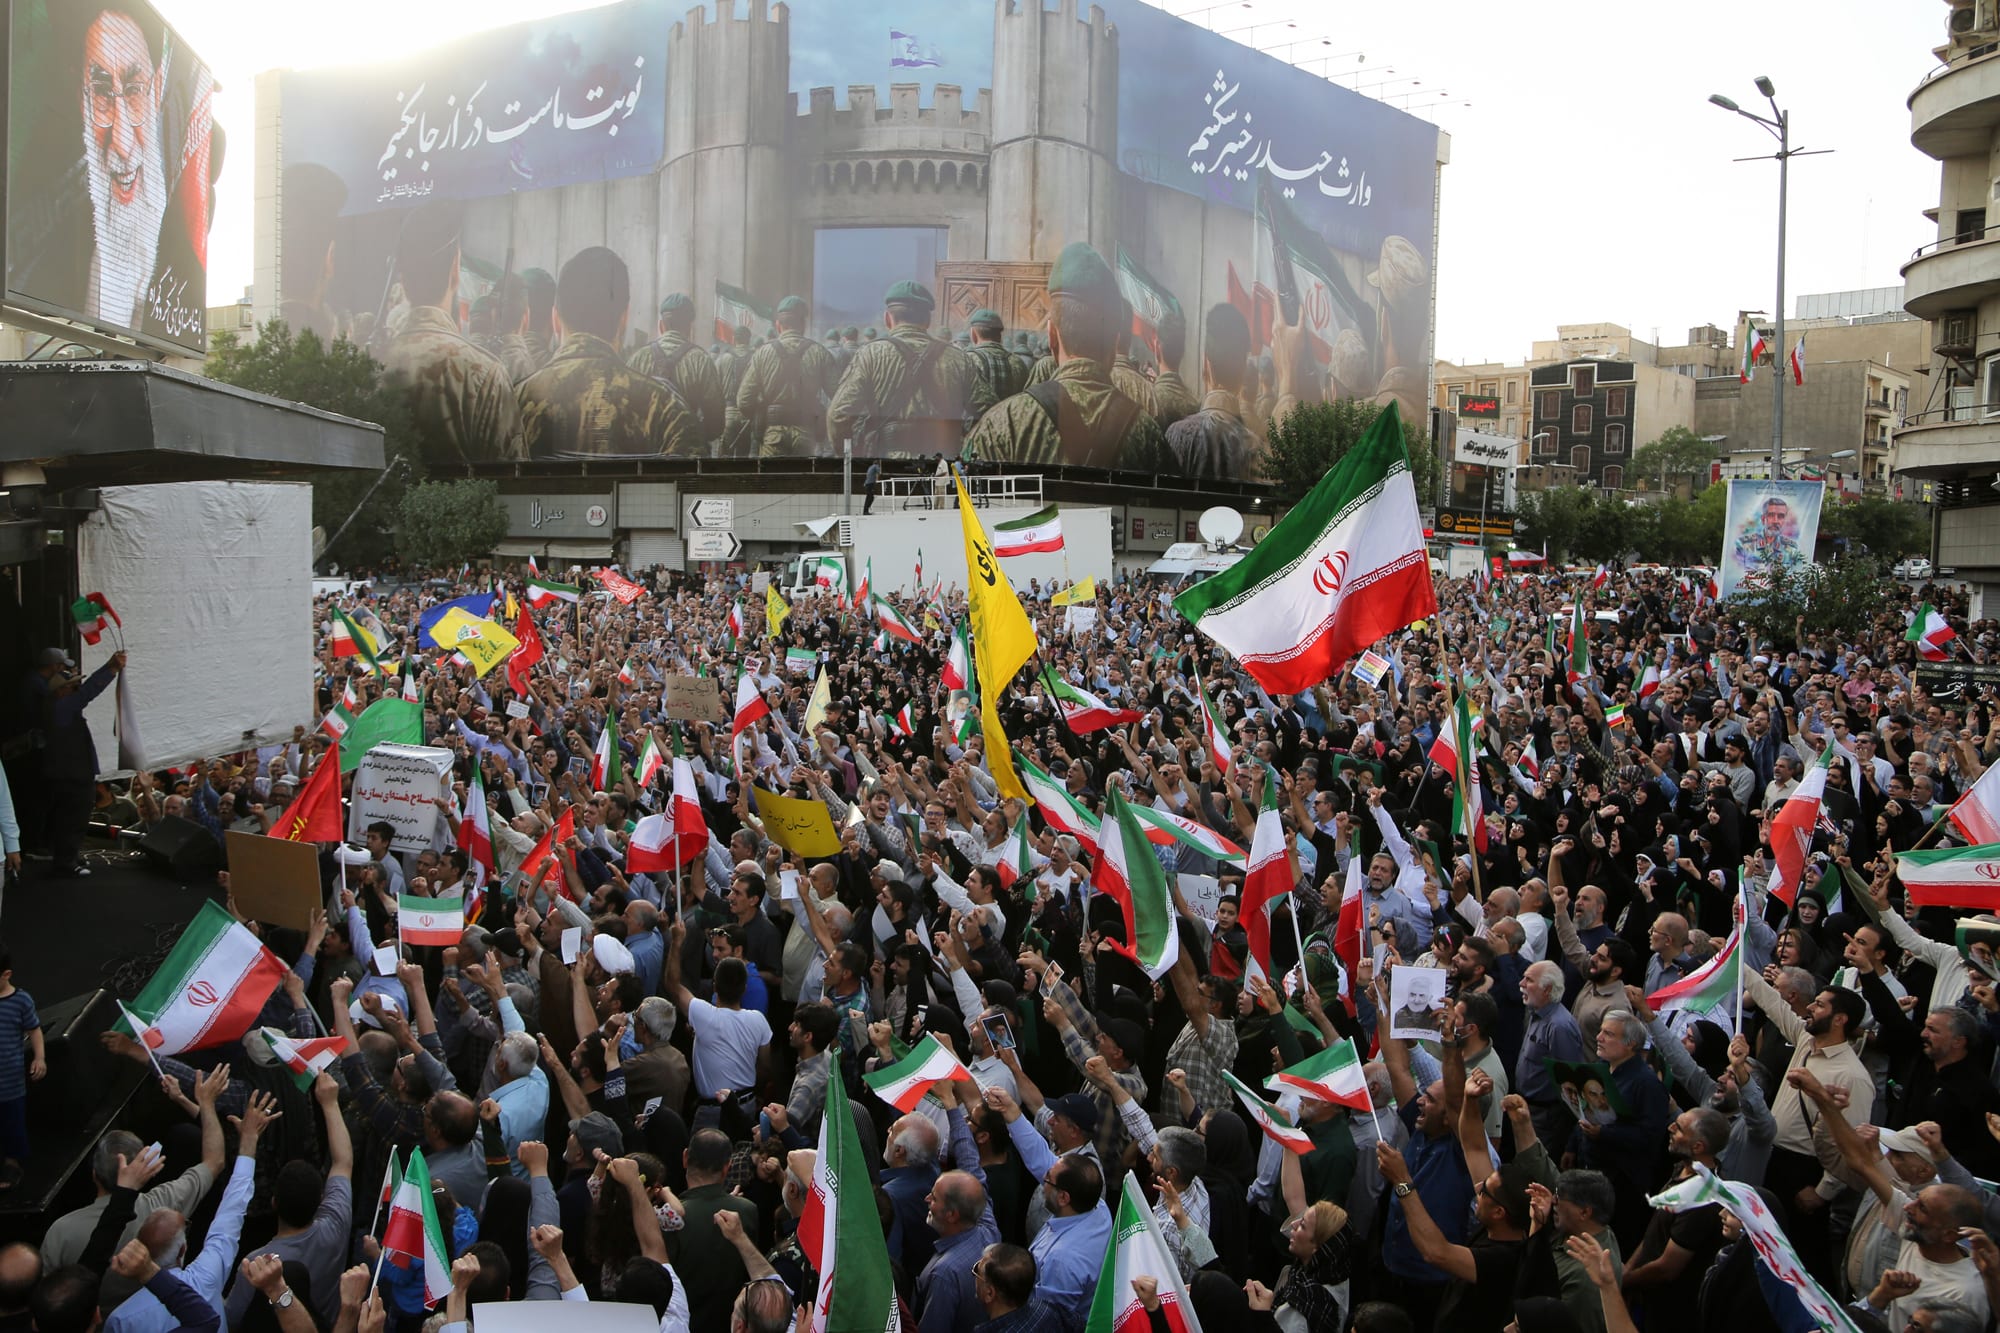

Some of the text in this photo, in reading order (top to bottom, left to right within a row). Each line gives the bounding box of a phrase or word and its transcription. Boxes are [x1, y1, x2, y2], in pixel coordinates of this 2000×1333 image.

[438, 94, 460, 150] از
[486, 86, 565, 144] ماست
[566, 56, 645, 137] نوبت
[418, 111, 440, 172] جا
[1187, 69, 1372, 207] وارث حیدر خیبر شکنیم
[1463, 398, 1496, 413] کامپیوتر
[356, 786, 383, 801] بسازید
[409, 792, 434, 807] سلاح
